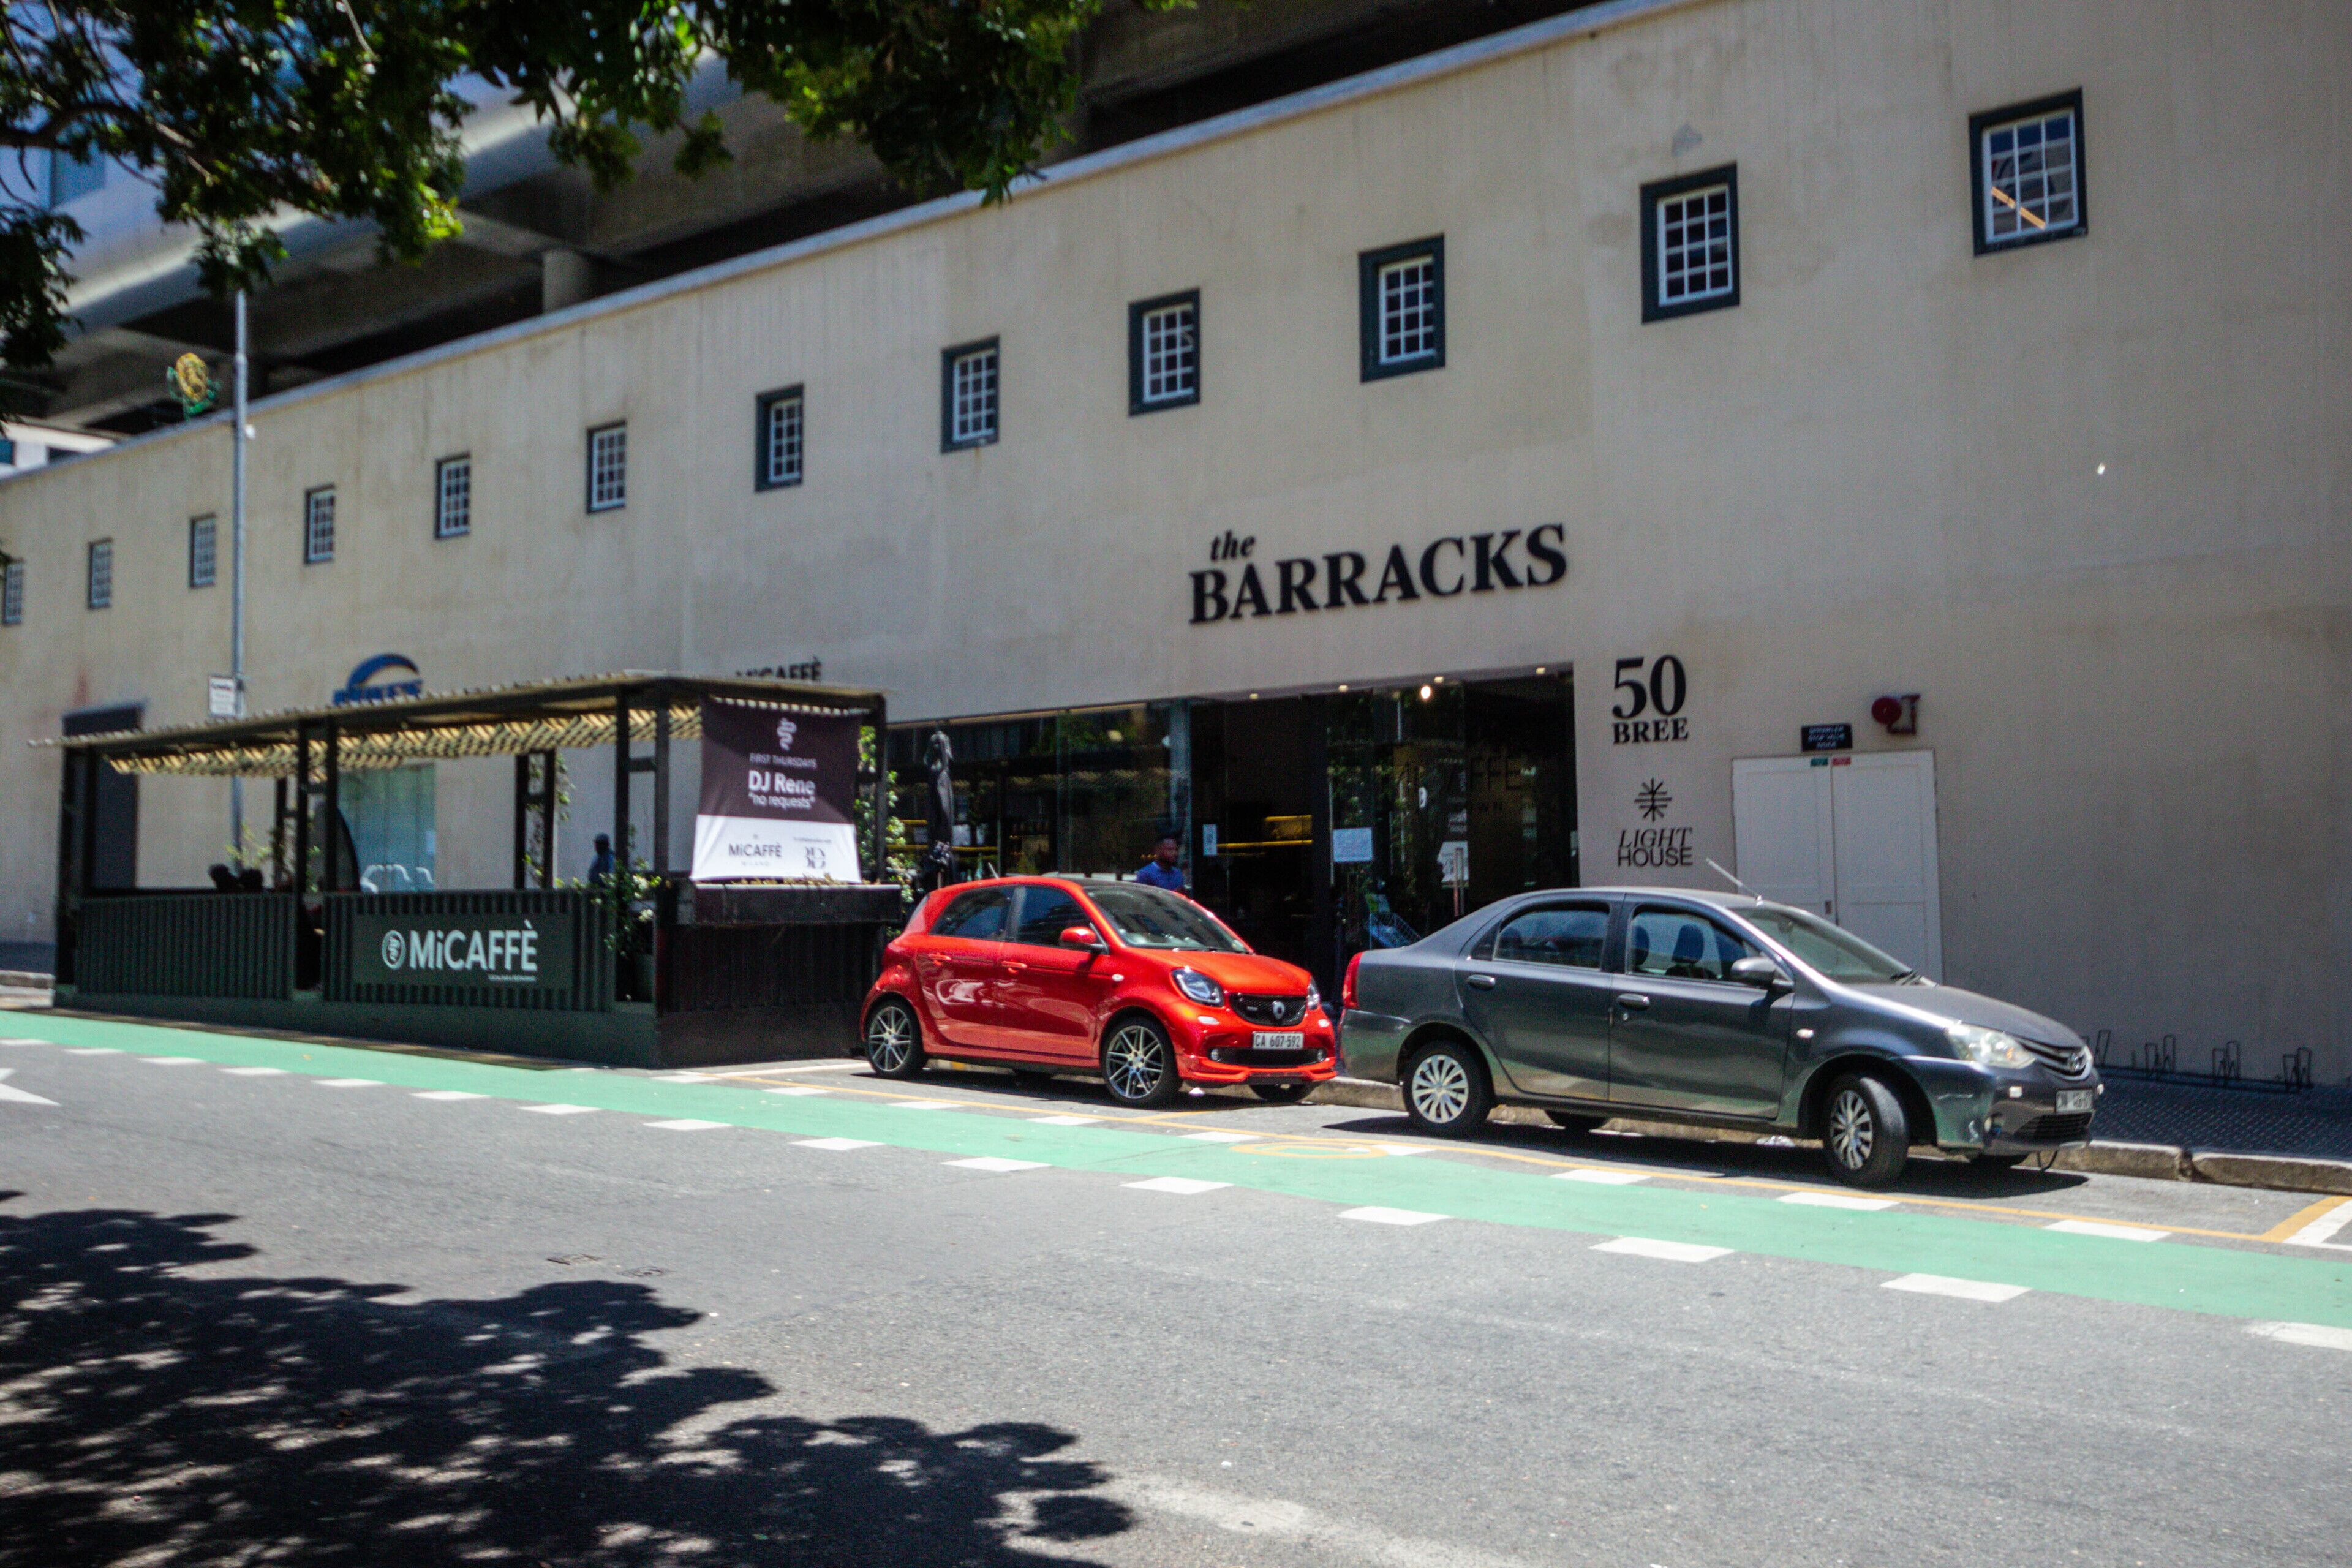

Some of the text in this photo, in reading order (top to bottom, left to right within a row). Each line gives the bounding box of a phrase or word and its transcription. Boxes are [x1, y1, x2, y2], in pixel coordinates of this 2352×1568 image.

[1210, 529, 1256, 562] the
[1189, 522, 1567, 625] BARRACKS
[1612, 654, 1687, 720] 50
[1612, 716, 1689, 745] BREE
[749, 752, 817, 769] FIRST THURSDAYS
[748, 769, 771, 793] DJ
[1619, 827, 1693, 848] LIGHT
[1617, 846, 1694, 867] HOUSE
[409, 918, 538, 971] MiCAFFÈ
[1255, 1034, 1266, 1047] CA
